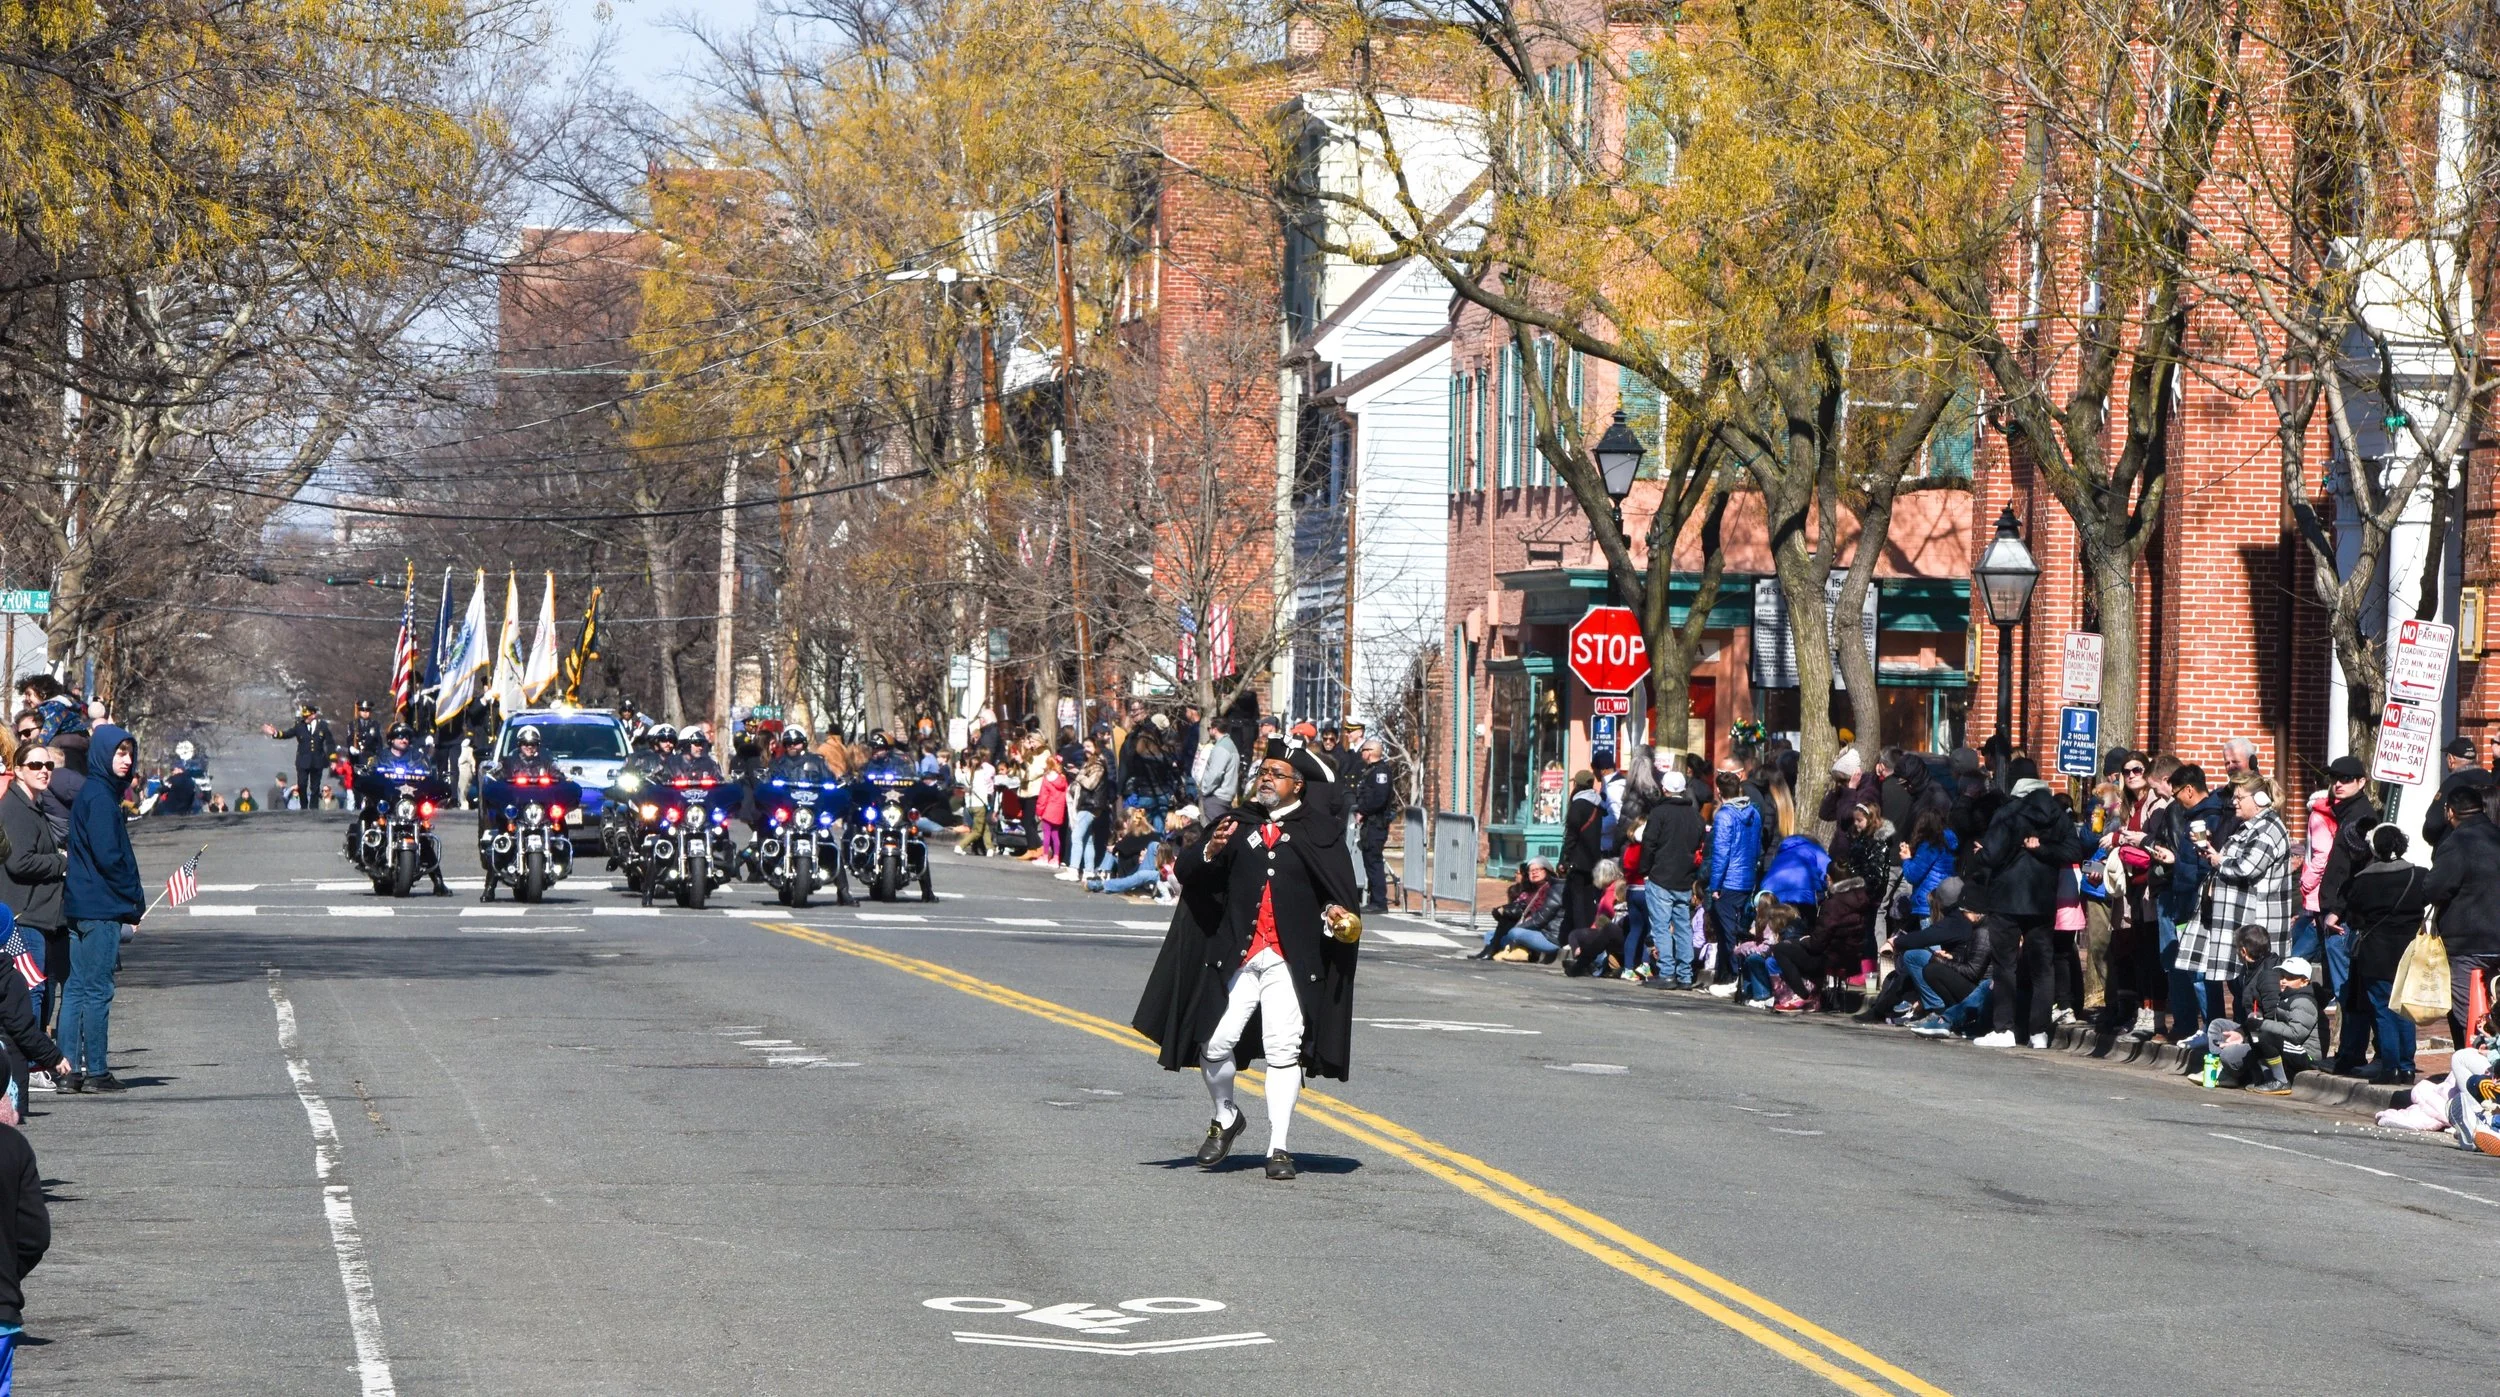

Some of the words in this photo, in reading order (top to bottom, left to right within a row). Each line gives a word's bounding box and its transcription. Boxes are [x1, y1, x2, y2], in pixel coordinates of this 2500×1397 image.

[38, 592, 48, 600] ST
[34, 601, 48, 609] 400
[2402, 624, 2416, 641] NO
[2418, 629, 2450, 643] PARKING
[1575, 633, 1646, 666] STOP
[2076, 637, 2091, 650] NO
[2066, 649, 2100, 663] PARKING
[2400, 646, 2428, 657] LOADING
[2429, 650, 2446, 660] ZONE
[2065, 660, 2085, 670] LOADING
[2400, 657, 2410, 666] 20
[2411, 659, 2424, 668] MIN
[2427, 662, 2442, 671] MAX
[2407, 670, 2419, 679] ALL
[2423, 672, 2442, 681] TIMES
[1597, 700, 1611, 711] ALL
[1613, 700, 1628, 711] WAY
[2074, 711, 2086, 731] P
[2385, 707, 2400, 724] NO
[2401, 712, 2432, 727] PARKING
[1599, 718, 1608, 733] P
[2073, 733, 2090, 741] HOUR
[2384, 729, 2411, 740] LOADING
[2412, 733, 2428, 743] ZONE
[2073, 741, 2096, 750] PARKING
[2383, 739, 2425, 755] 9AM-7PM
